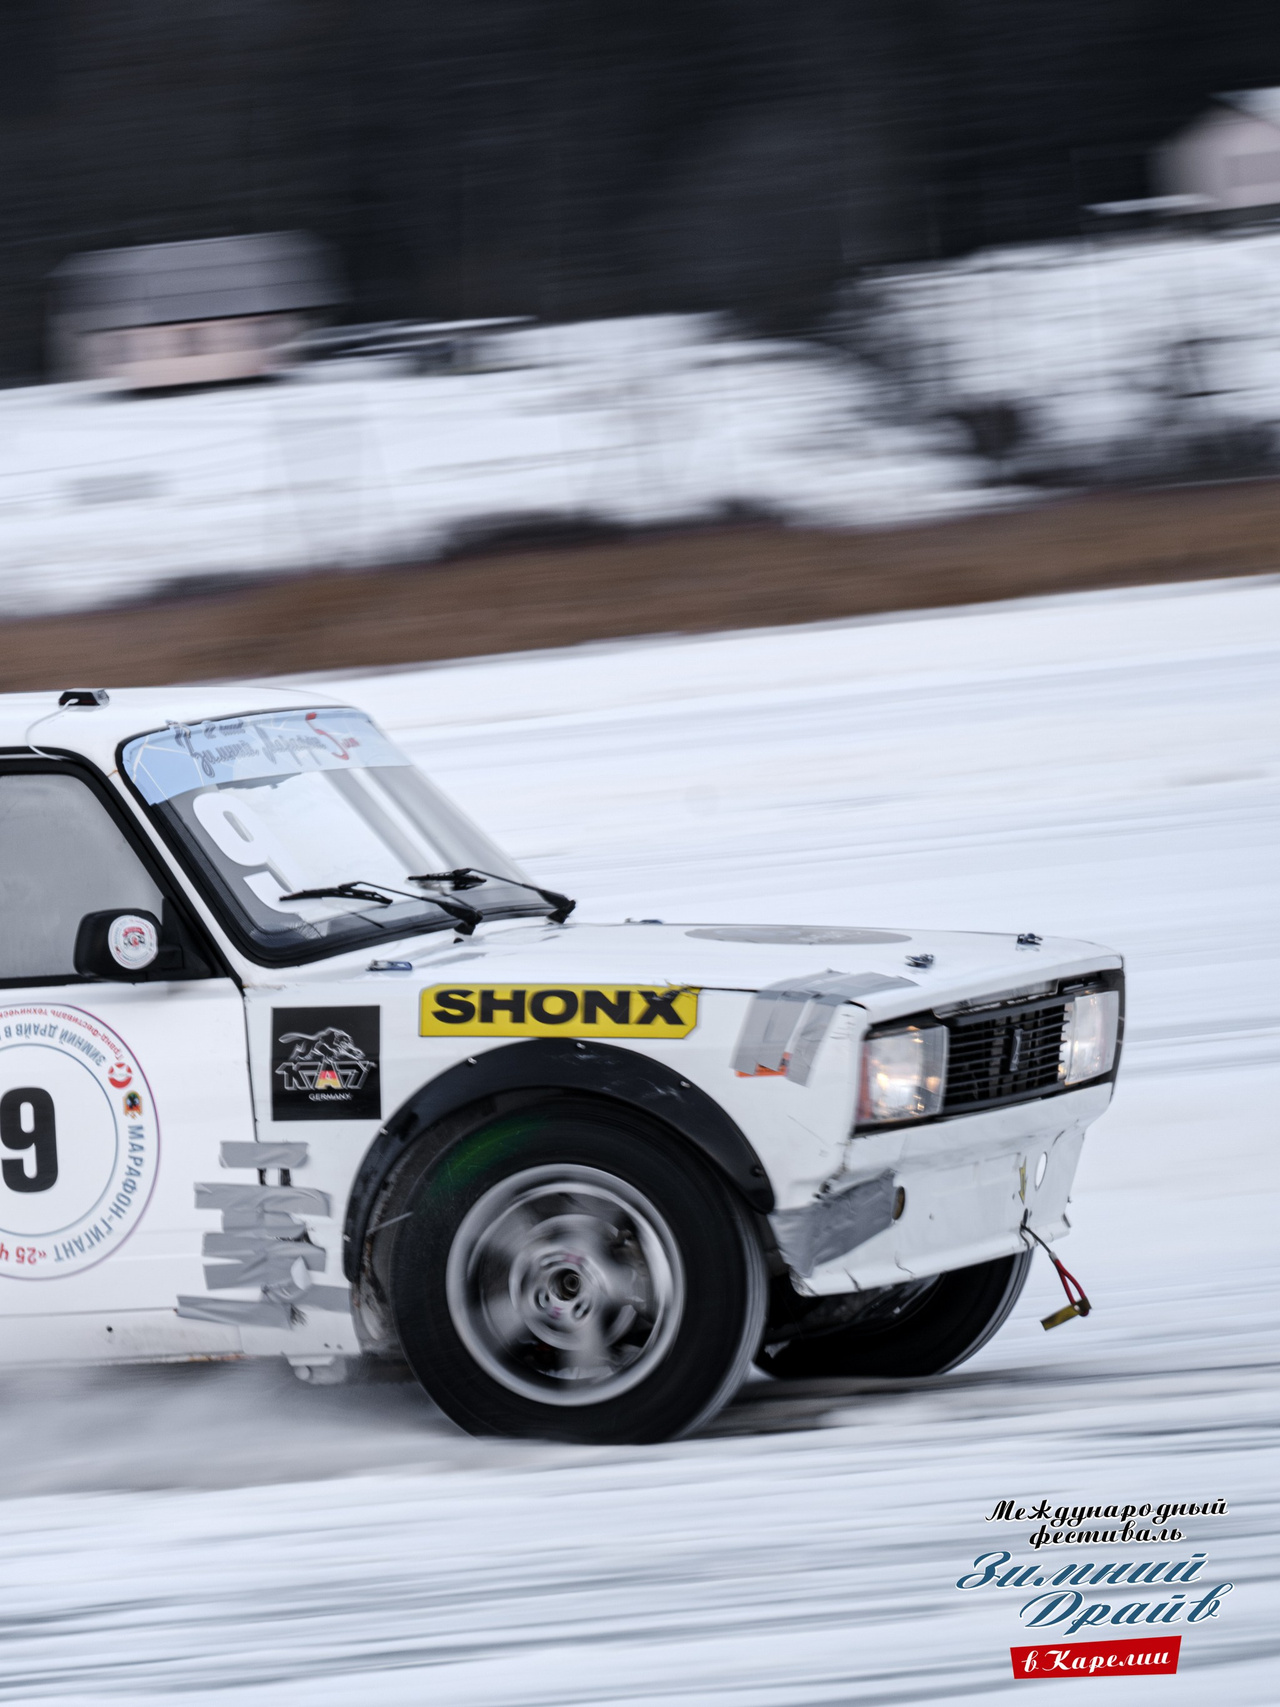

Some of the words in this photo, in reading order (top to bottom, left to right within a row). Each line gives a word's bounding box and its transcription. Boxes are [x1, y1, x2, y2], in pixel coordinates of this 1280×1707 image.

[432, 989, 686, 1026] SHONX
[4, 1024, 12, 1038] В
[15, 1022, 58, 1039] ДРАЙВ
[59, 1028, 108, 1067] ЗИМНИЙ
[308, 1093, 353, 1102] GERMANY
[0, 1086, 58, 1193] 9
[53, 1124, 145, 1262] МАРАФОН-ГИГАНТ
